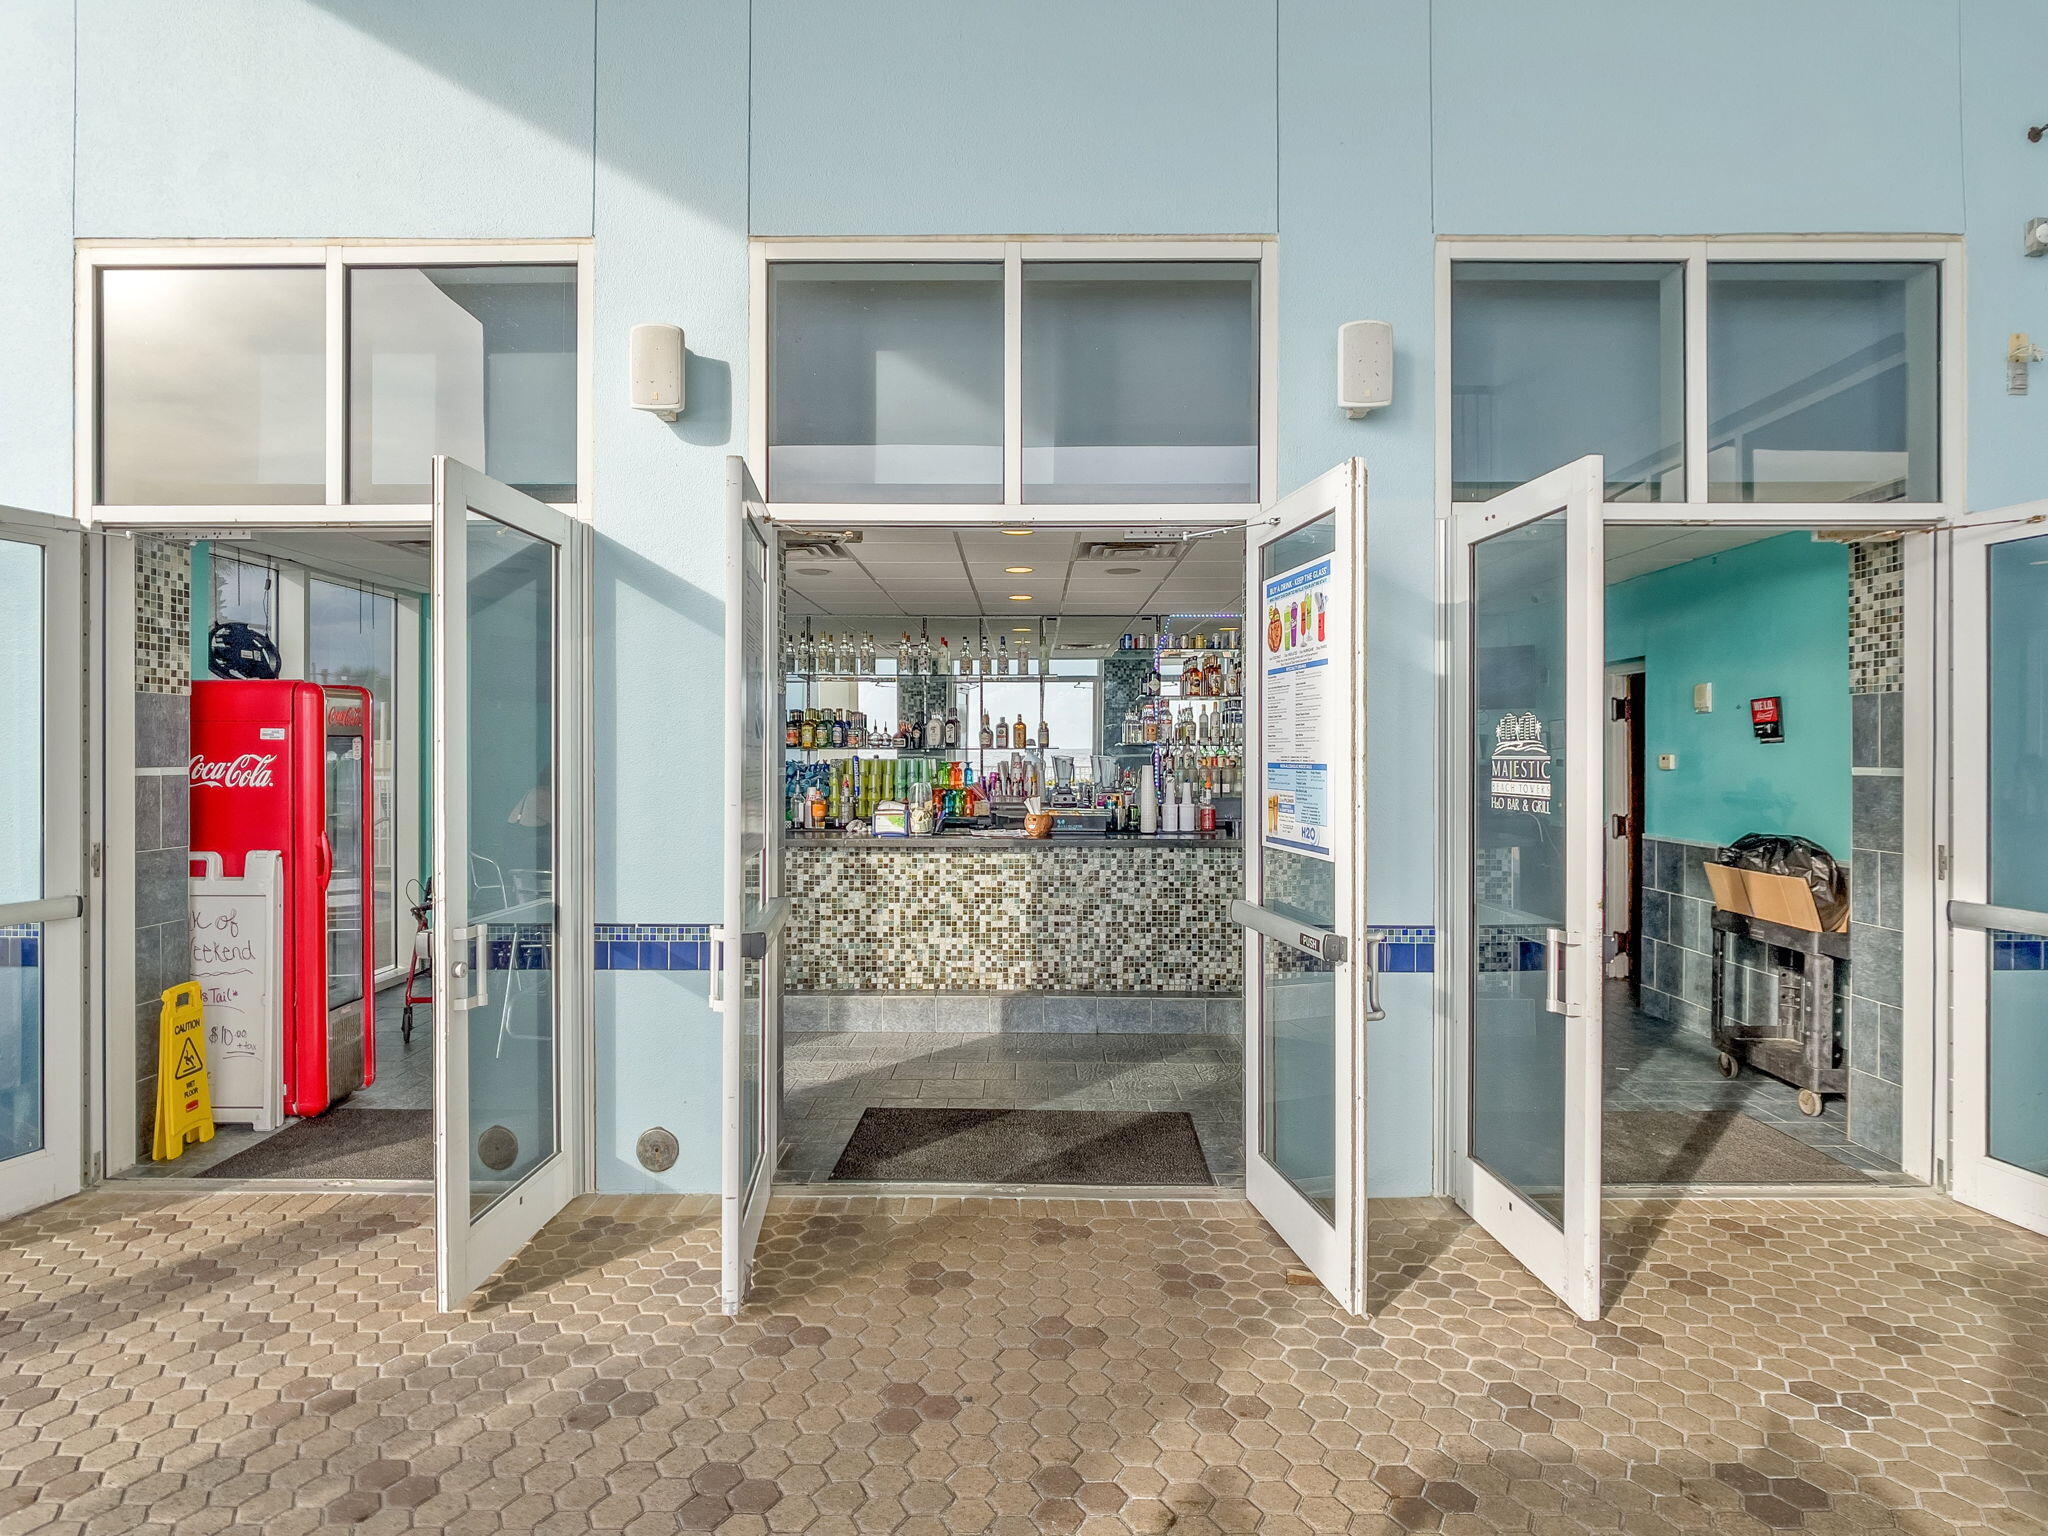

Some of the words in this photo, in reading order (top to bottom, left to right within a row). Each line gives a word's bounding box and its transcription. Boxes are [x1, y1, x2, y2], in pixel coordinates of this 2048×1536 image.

[1491, 760, 1551, 780] MAJESTIC
[1491, 782, 1515, 793] BEACH
[1519, 784, 1550, 796] TOWERS
[1507, 798, 1520, 811] BAR
[1522, 799, 1529, 812] &
[1531, 800, 1551, 815] GRILL
[1301, 825, 1316, 841] H2O
[216, 908, 239, 937] of
[174, 1017, 201, 1035] CAUTION
[184, 1087, 199, 1099] FLOOR
